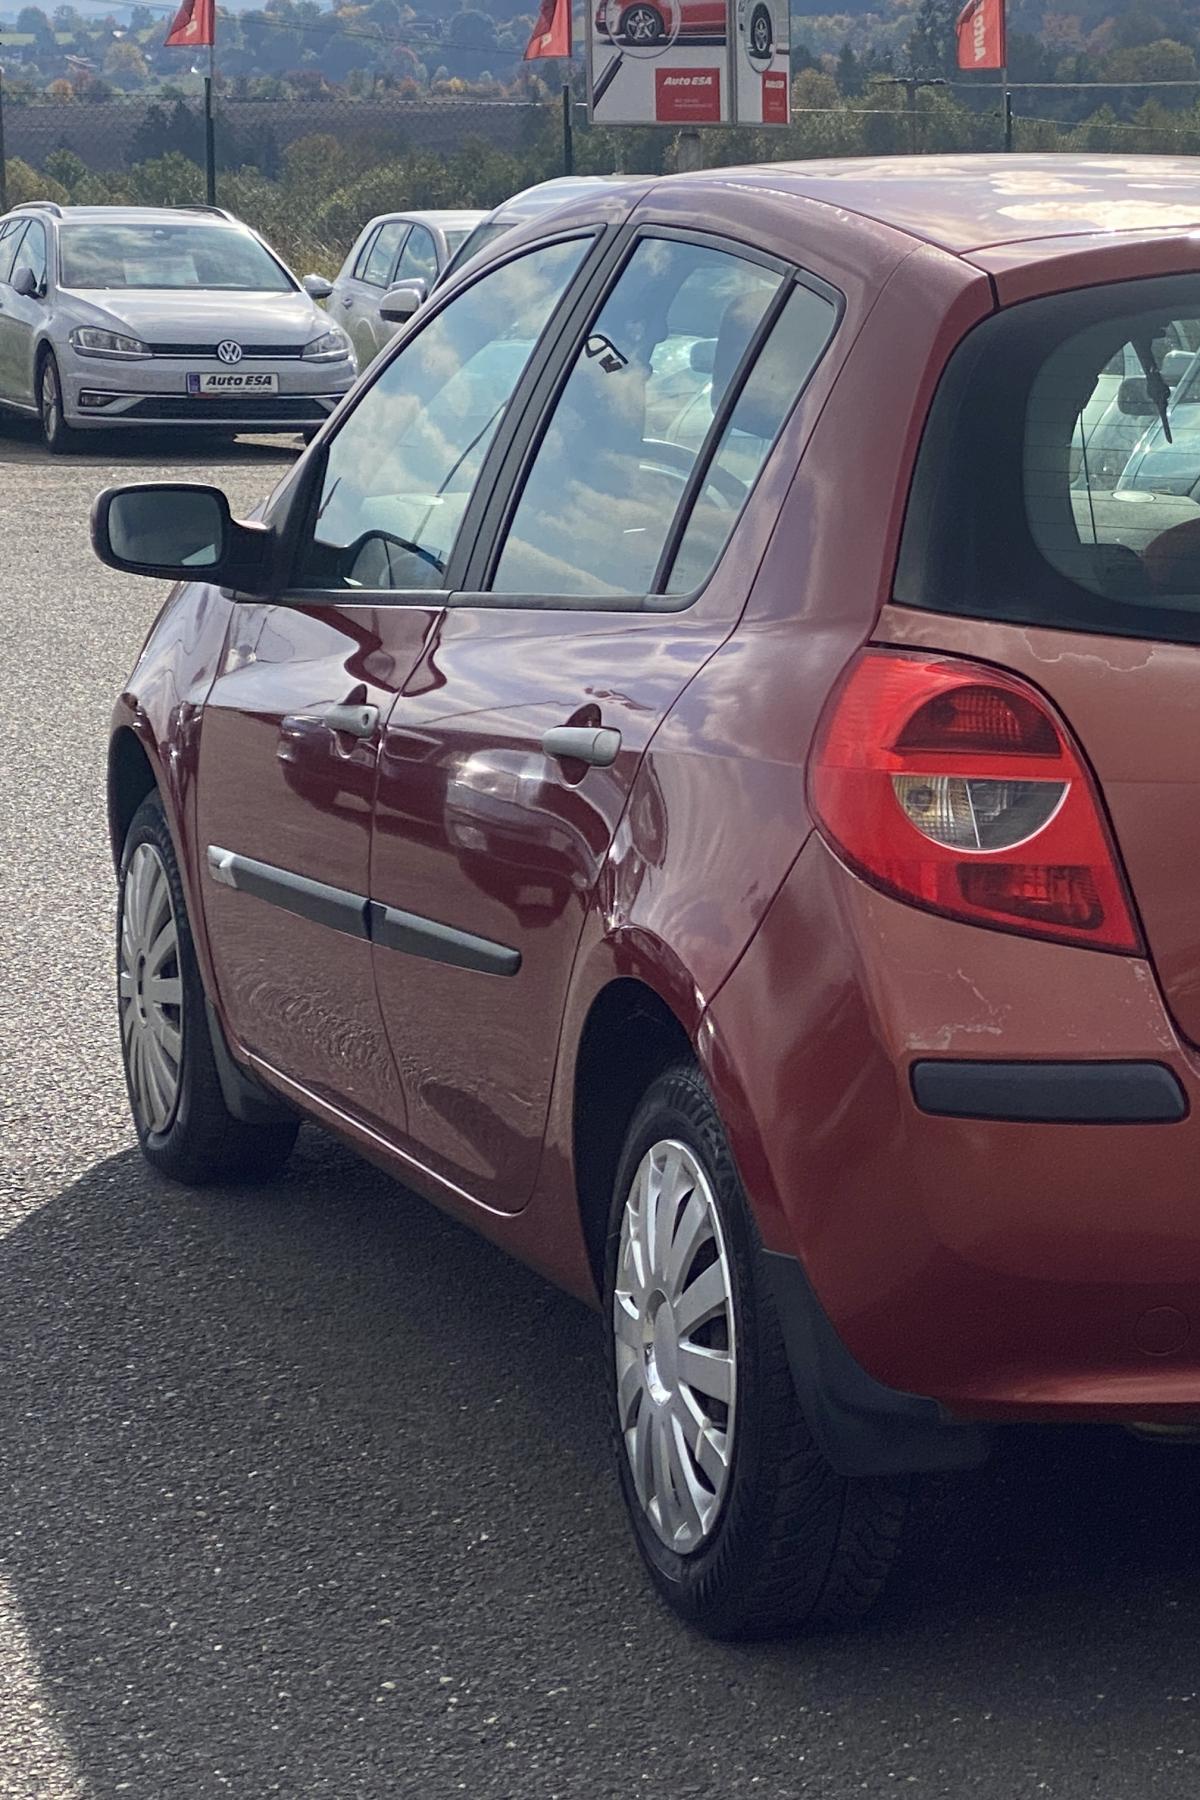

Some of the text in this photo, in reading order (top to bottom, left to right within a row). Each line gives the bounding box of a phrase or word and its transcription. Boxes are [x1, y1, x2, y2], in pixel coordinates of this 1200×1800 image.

[663, 76, 712, 86] Auto ESA
[206, 376, 272, 386] Auto ESA
